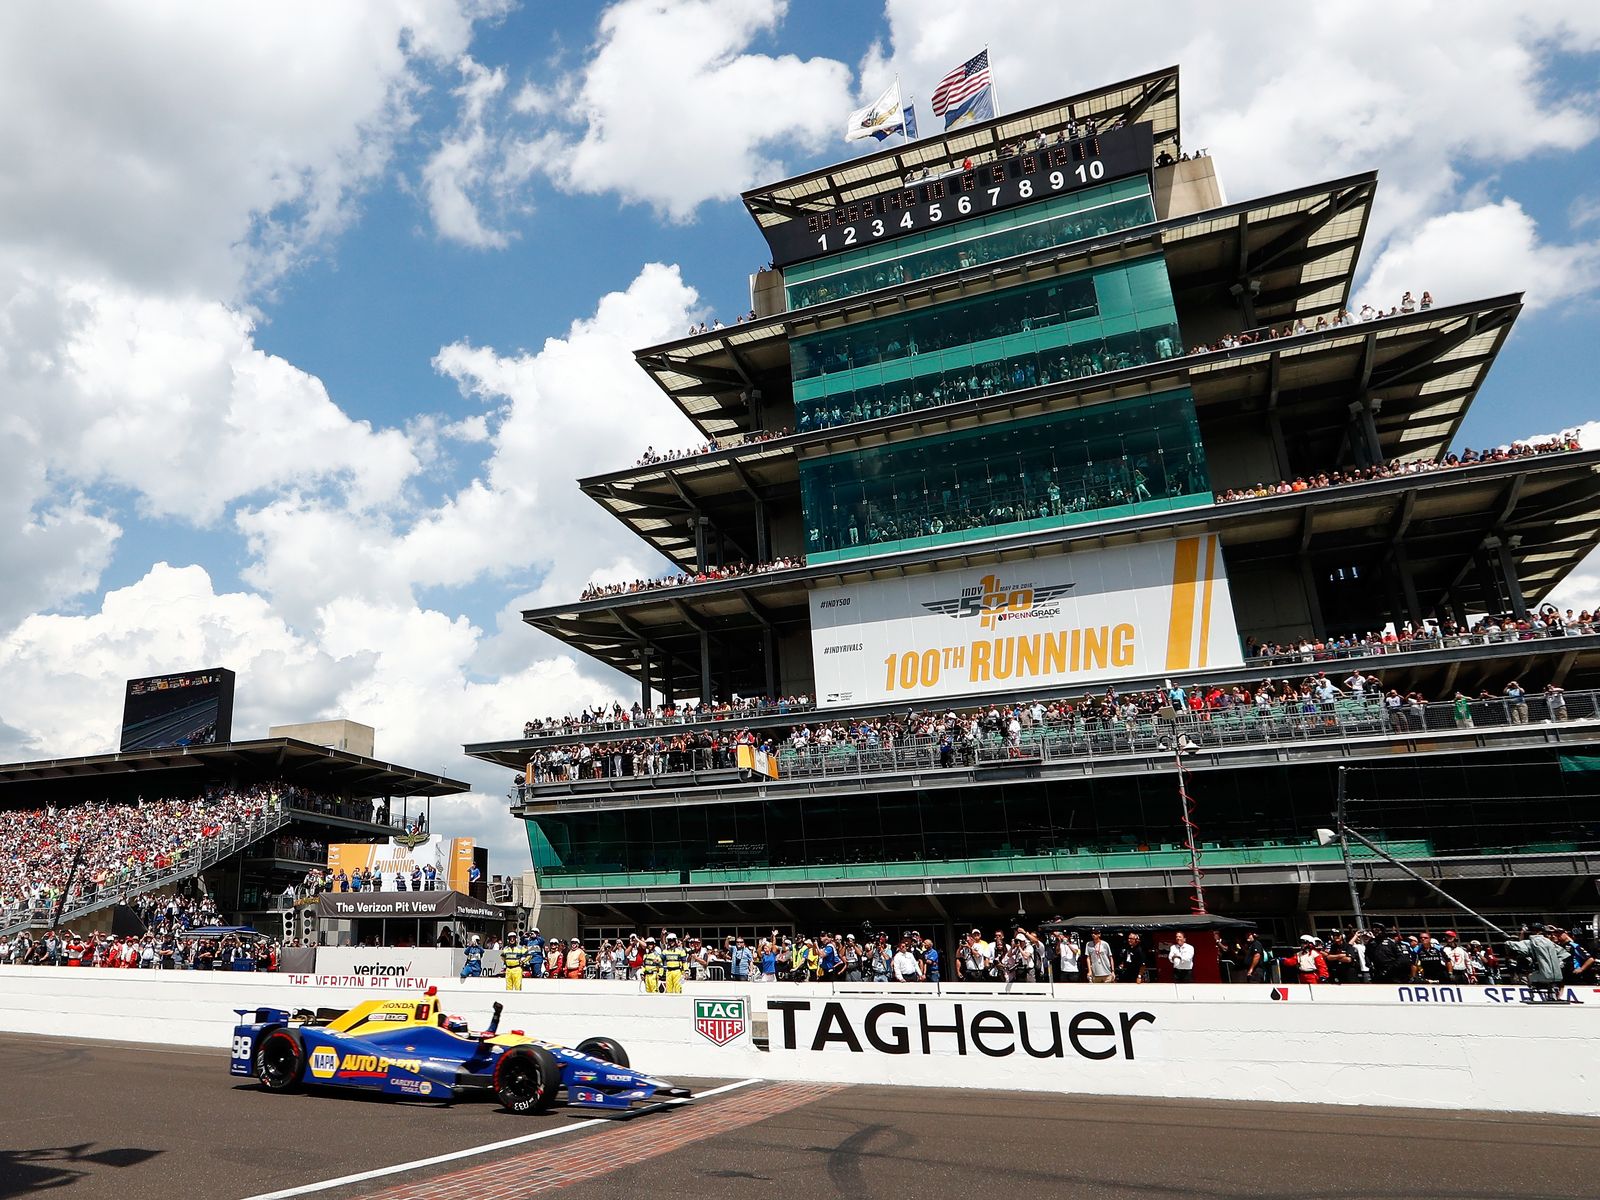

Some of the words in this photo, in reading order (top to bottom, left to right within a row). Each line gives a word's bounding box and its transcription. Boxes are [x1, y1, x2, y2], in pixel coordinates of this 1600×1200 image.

[808, 212, 831, 233] 98
[835, 205, 859, 225] 26
[862, 197, 887, 219] 21
[891, 189, 916, 209] 42
[926, 181, 945, 201] 10
[1023, 156, 1036, 174] 9
[1047, 147, 1067, 168] 12
[1079, 138, 1100, 159] 11
[817, 233, 828, 251] 1
[843, 226, 857, 245] 2
[871, 219, 885, 237] 3
[900, 211, 914, 229] 4
[929, 203, 943, 222] 5
[957, 196, 972, 214] 6
[987, 187, 1001, 206] 7
[1018, 179, 1033, 198] 8
[1049, 171, 1064, 190] 9
[1075, 160, 1104, 183] 10
[961, 586, 983, 597] INDY
[820, 597, 851, 609] #INDY500
[958, 589, 1035, 619] 500
[823, 643, 864, 655] #INDYRIVALS
[884, 646, 966, 691] 100TH
[969, 623, 1135, 682] RUNNING
[336, 902, 355, 913] The
[356, 902, 393, 913] Verizon
[395, 901, 410, 912] Pit
[411, 901, 437, 912] View
[353, 962, 405, 976] verizon
[288, 975, 310, 985] THE
[698, 1003, 740, 1018] TAG
[698, 1020, 742, 1041] HEUER
[231, 1035, 252, 1060] 98
[314, 1054, 335, 1070] NAPA
[340, 1054, 377, 1071] AUTO
